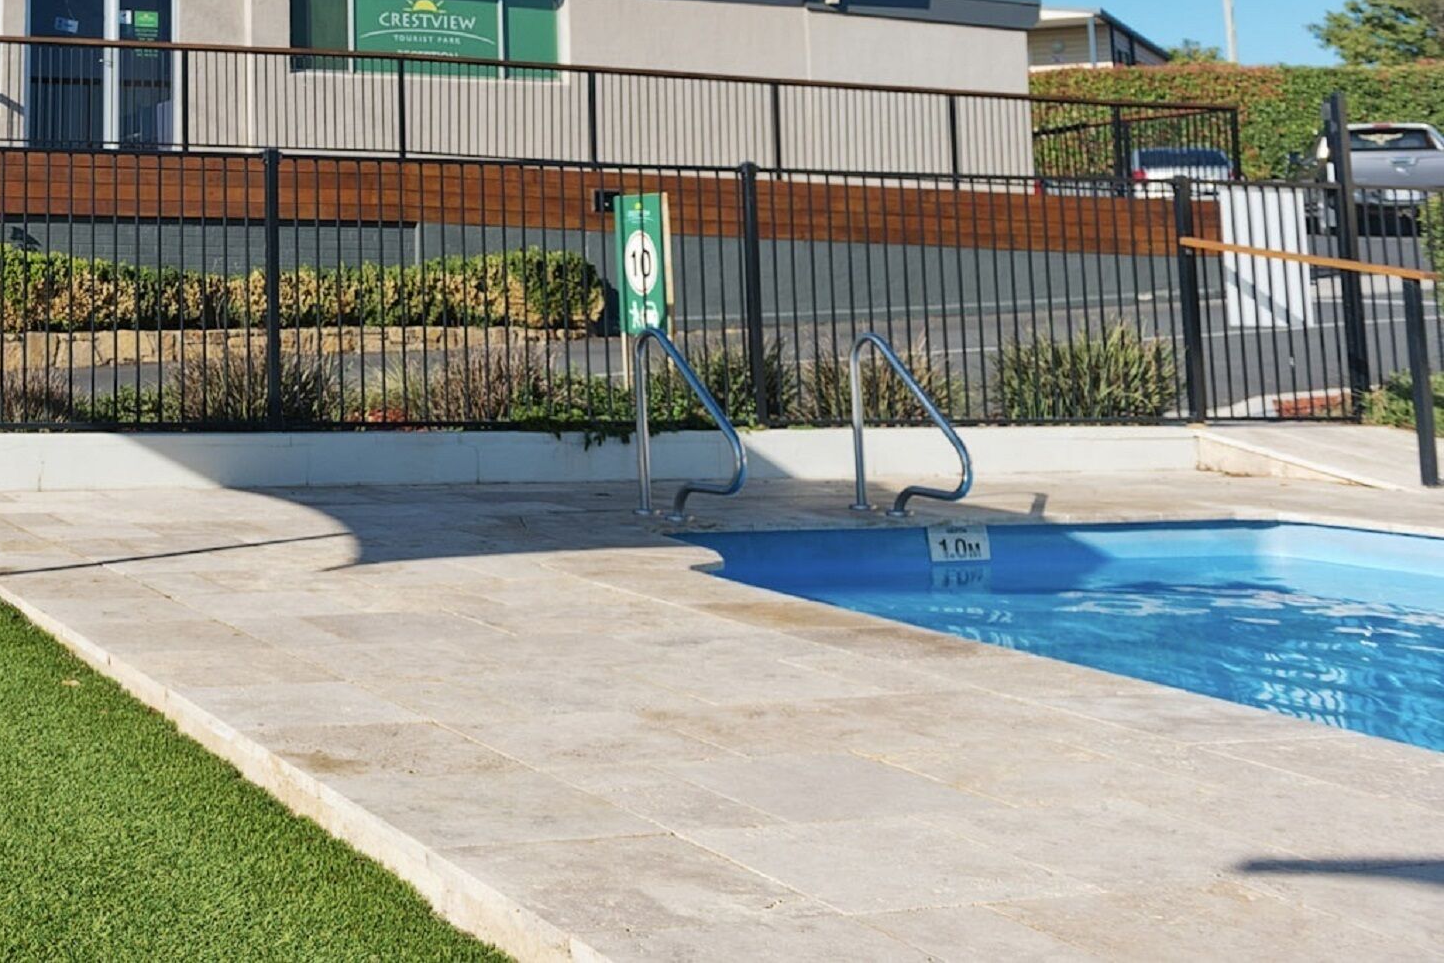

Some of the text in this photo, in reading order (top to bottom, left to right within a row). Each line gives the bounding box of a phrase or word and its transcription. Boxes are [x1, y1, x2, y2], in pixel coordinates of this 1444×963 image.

[379, 12, 476, 30] CRESTVIEW
[394, 34, 461, 45] TOURIST PARK
[631, 249, 651, 277] 10
